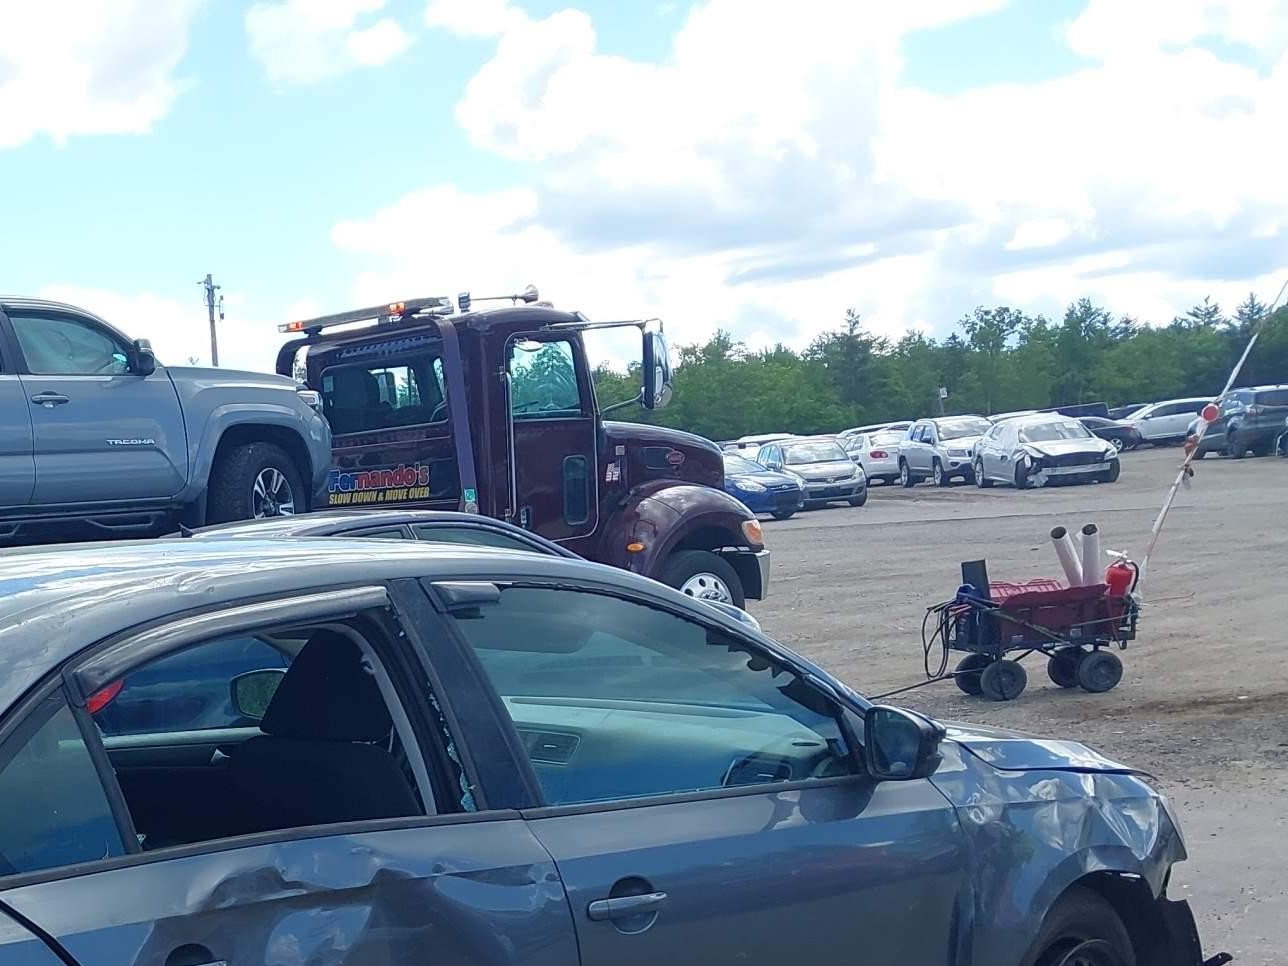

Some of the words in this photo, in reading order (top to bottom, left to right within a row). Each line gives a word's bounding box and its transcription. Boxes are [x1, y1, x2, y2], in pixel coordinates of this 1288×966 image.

[328, 462, 430, 493] Fernando's
[329, 493, 352, 505] SLOW
[352, 491, 377, 503] DOWN
[377, 492, 384, 501] &
[385, 488, 408, 500] MOVE
[408, 487, 430, 499] OVER
